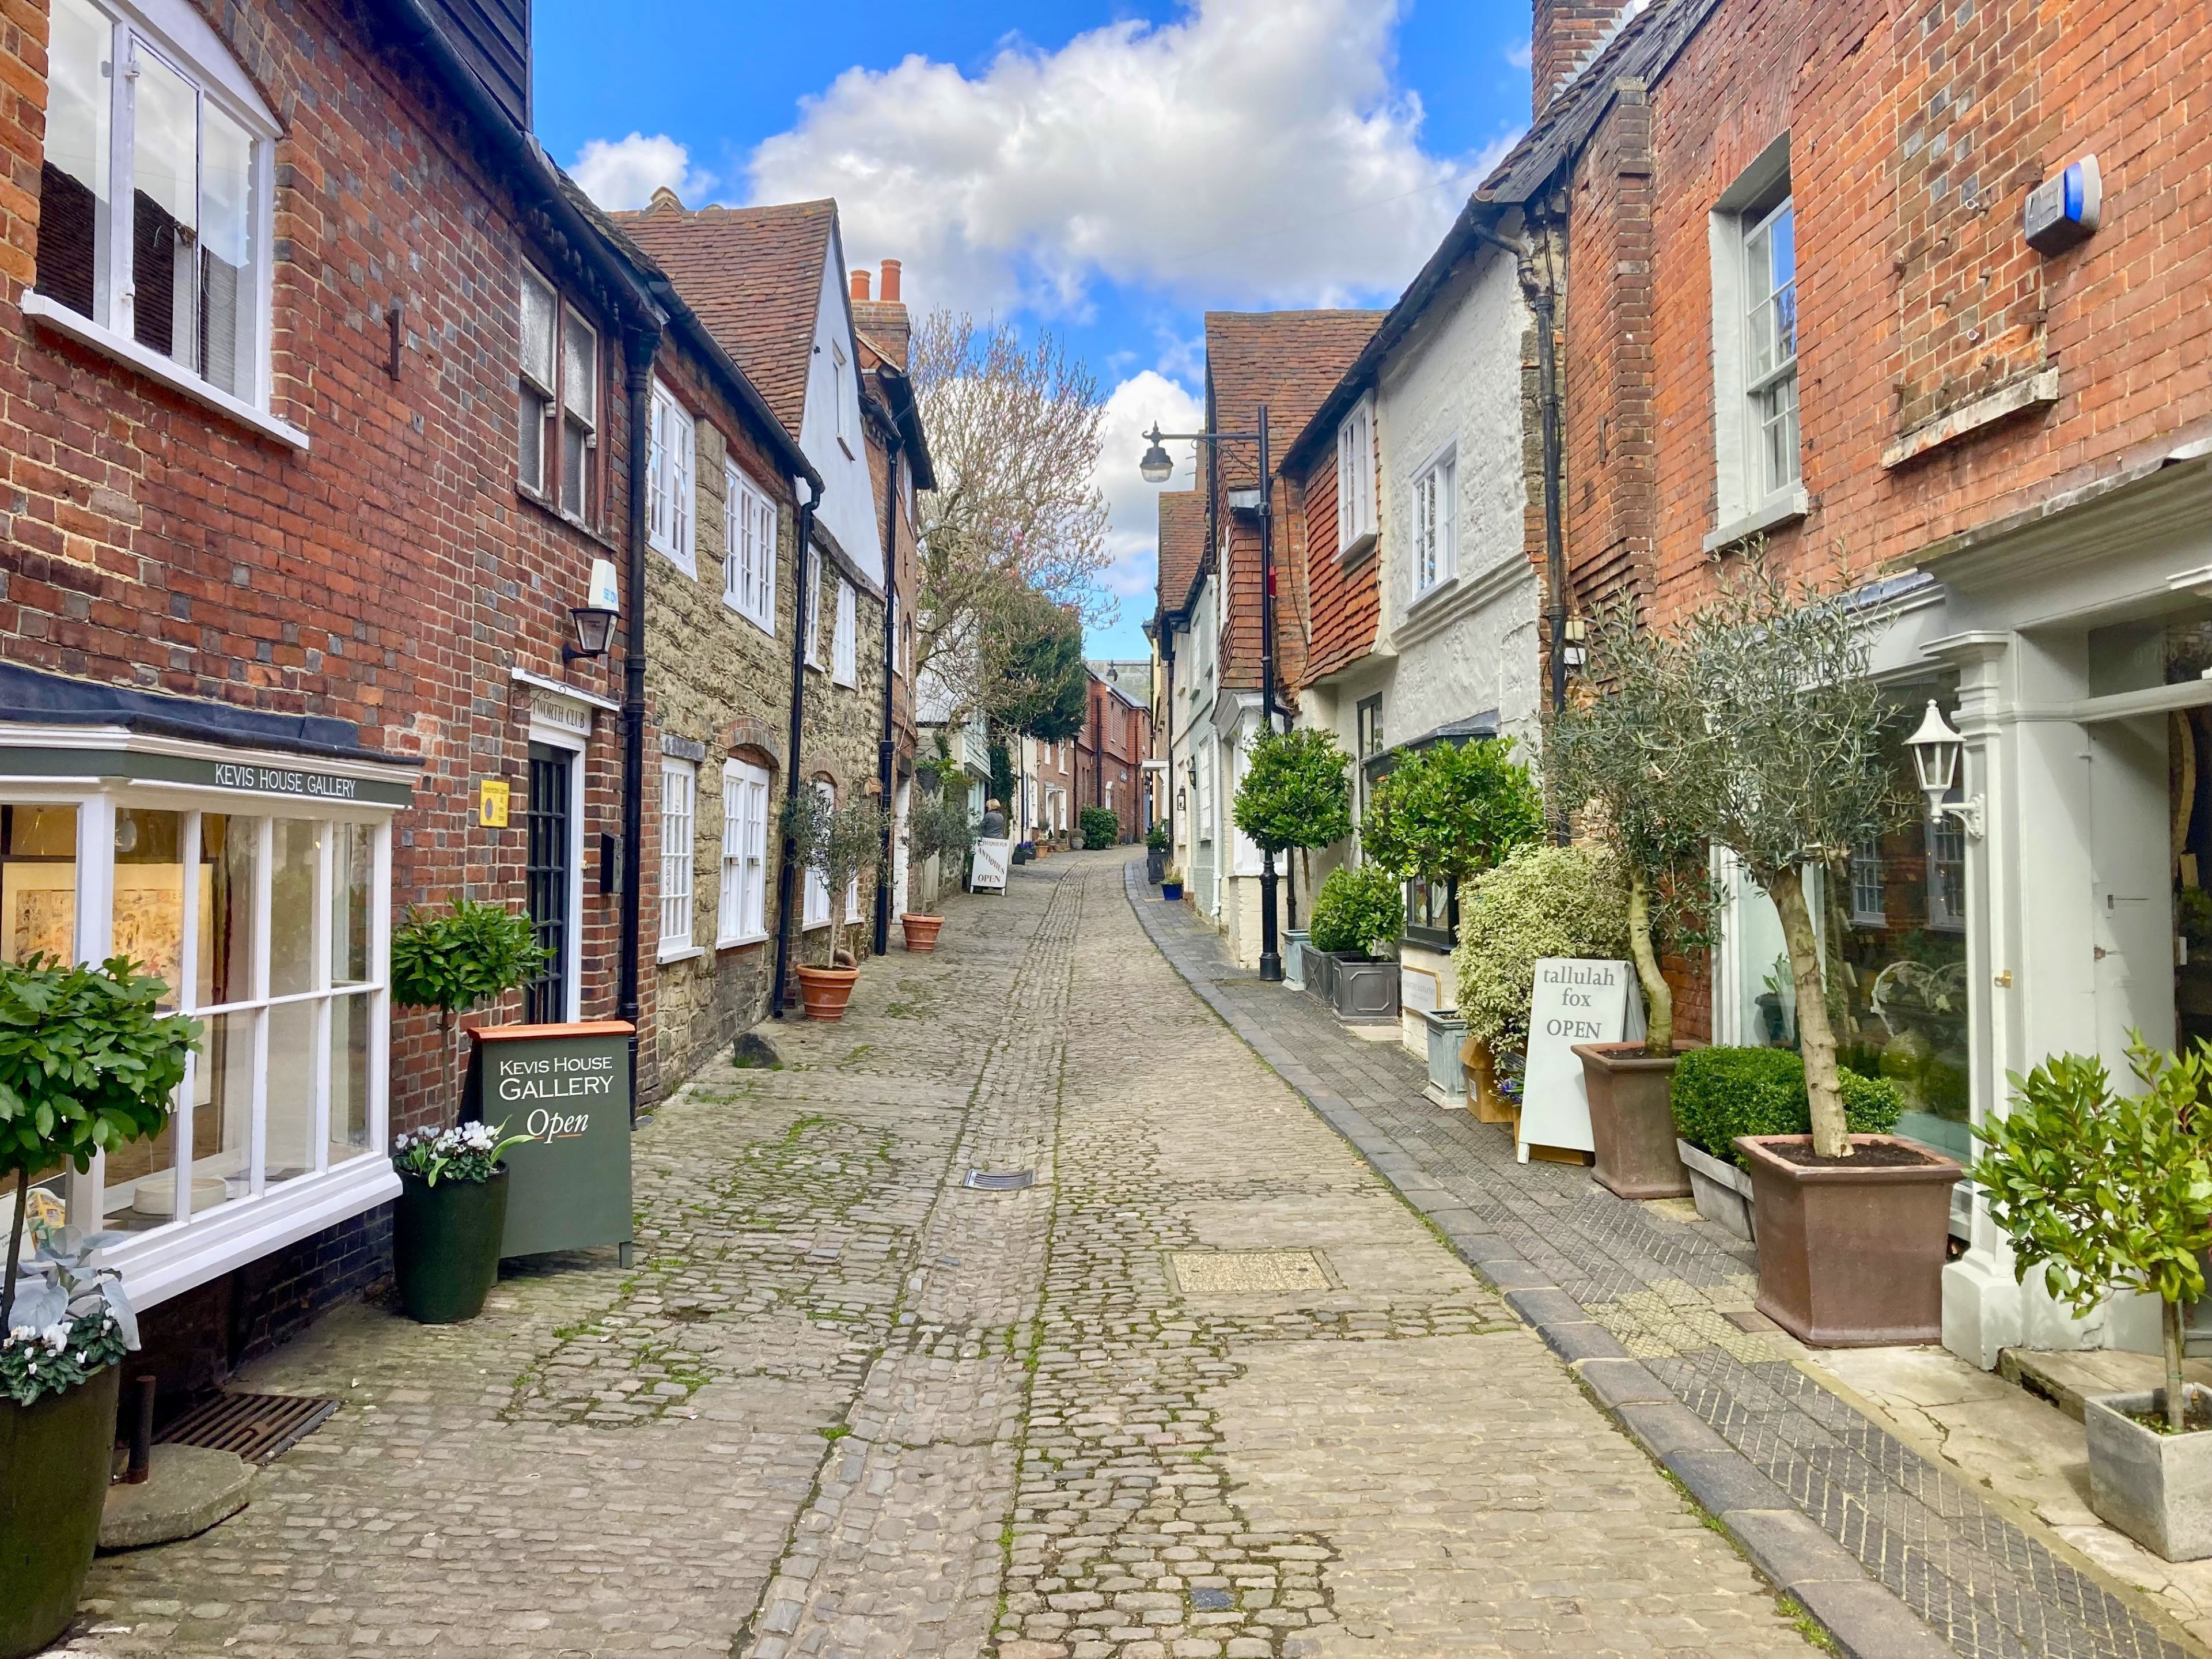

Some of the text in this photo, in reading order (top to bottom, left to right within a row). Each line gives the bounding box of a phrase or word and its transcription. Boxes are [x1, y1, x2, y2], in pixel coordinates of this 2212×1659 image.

[567, 709, 585, 728] CLUB
[215, 763, 356, 798] KEVIS HOUSE GALLERY
[978, 847, 1005, 875] ANTIQUES
[978, 874, 1001, 882] OPEN
[1543, 966, 1615, 986] tallulah
[1562, 988, 1592, 1007] fox
[1547, 1019, 1602, 1039] OPEN
[499, 1056, 612, 1076] KEVIS HOUSE
[499, 1075, 615, 1101] GALLERY
[527, 1108, 589, 1144] Open
